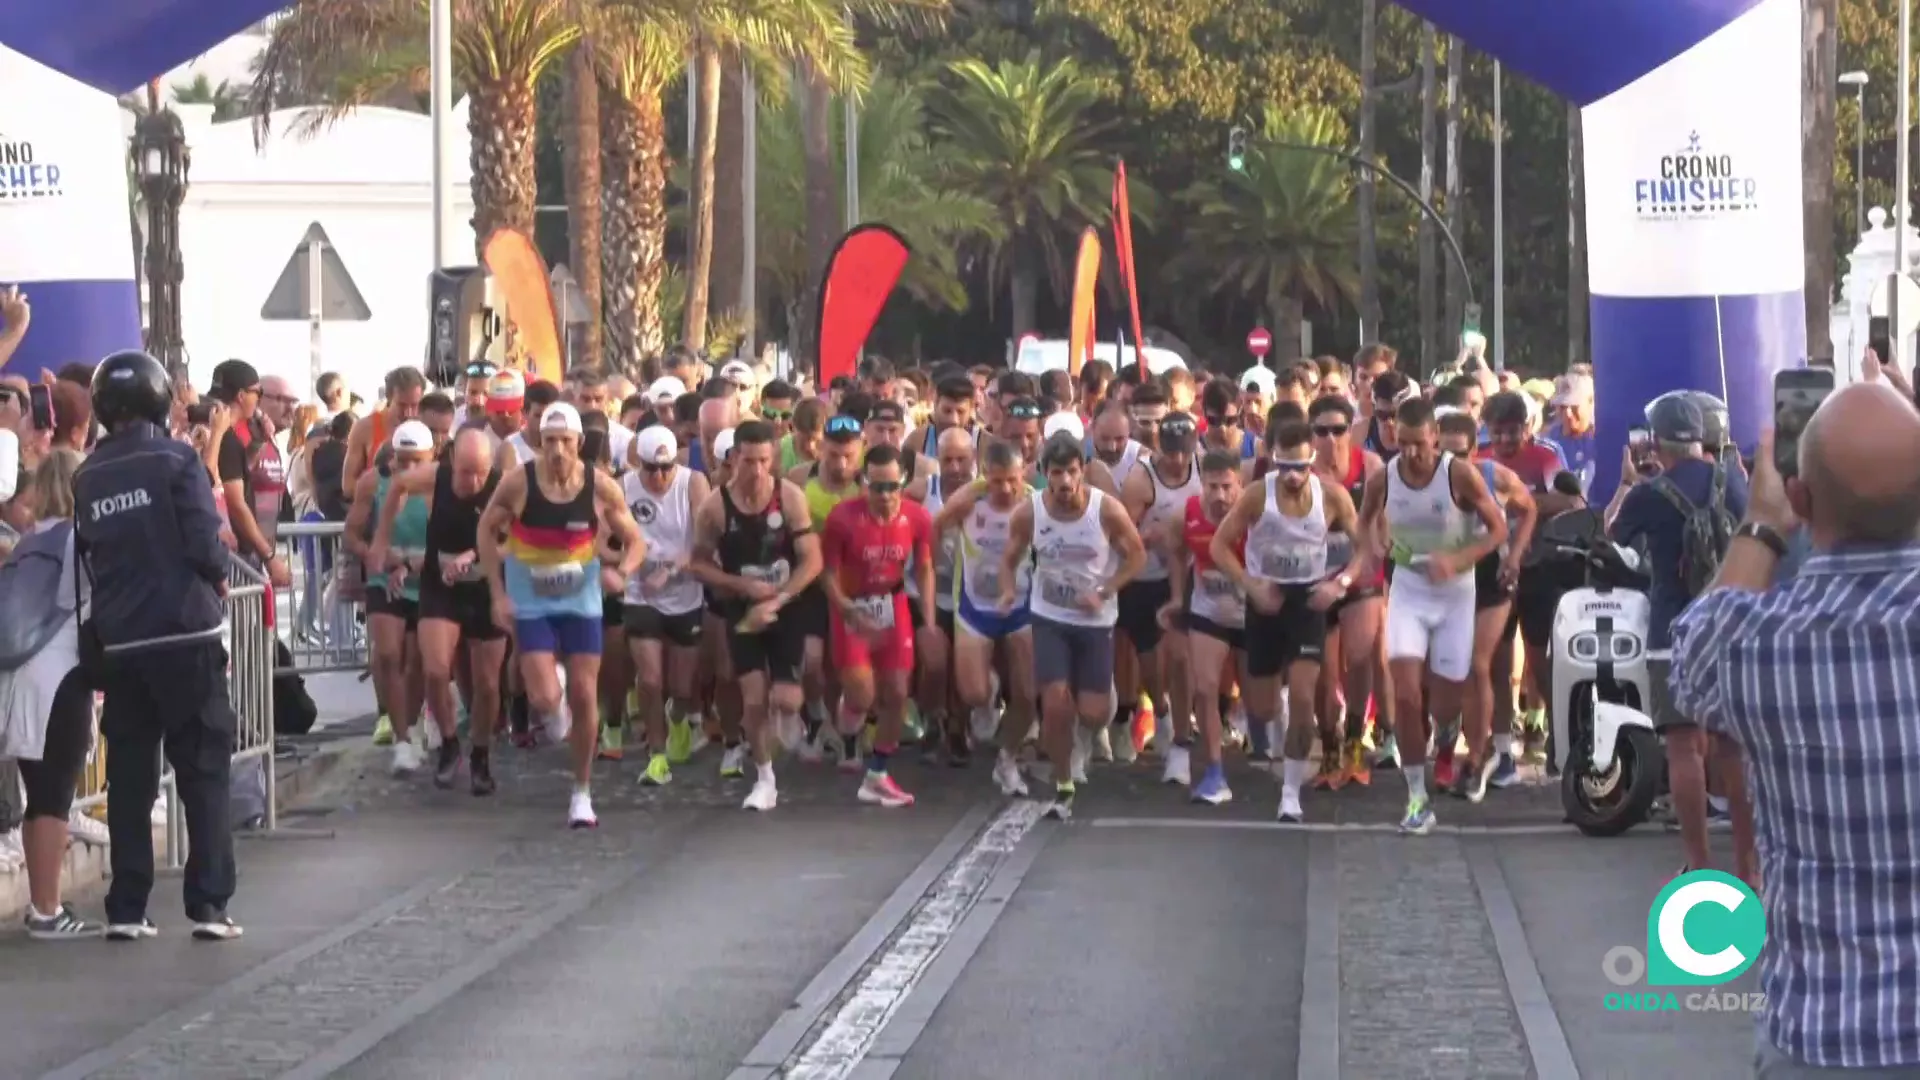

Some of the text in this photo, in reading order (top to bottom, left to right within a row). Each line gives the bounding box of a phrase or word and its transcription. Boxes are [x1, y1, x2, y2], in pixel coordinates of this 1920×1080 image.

[0, 141, 33, 165] NO
[1660, 155, 1732, 179] CRONO
[1635, 178, 1757, 213] FINISHER
